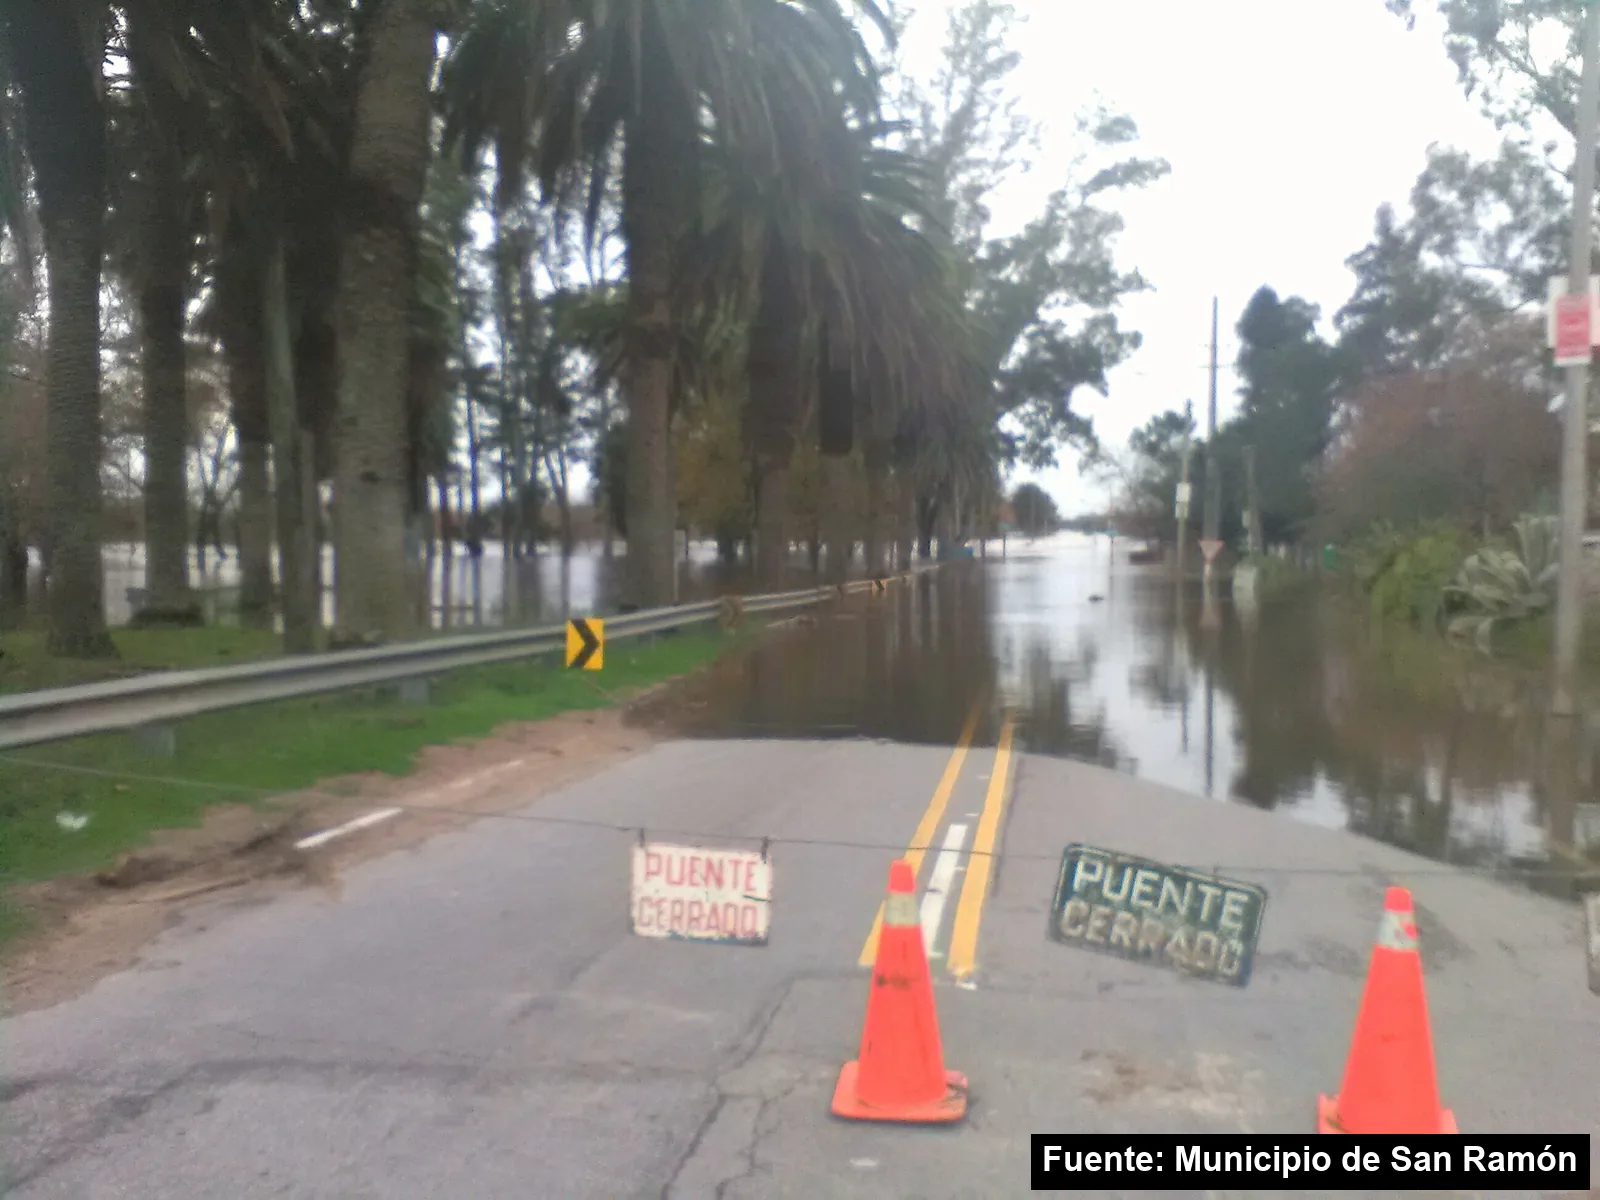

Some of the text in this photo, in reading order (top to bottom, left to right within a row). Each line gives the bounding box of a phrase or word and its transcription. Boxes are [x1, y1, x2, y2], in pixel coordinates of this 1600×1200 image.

[644, 853, 758, 892] PUENTE
[1072, 854, 1249, 930] PUENTE
[638, 896, 758, 937] CERRADO
[1060, 899, 1245, 977] CERRADO
